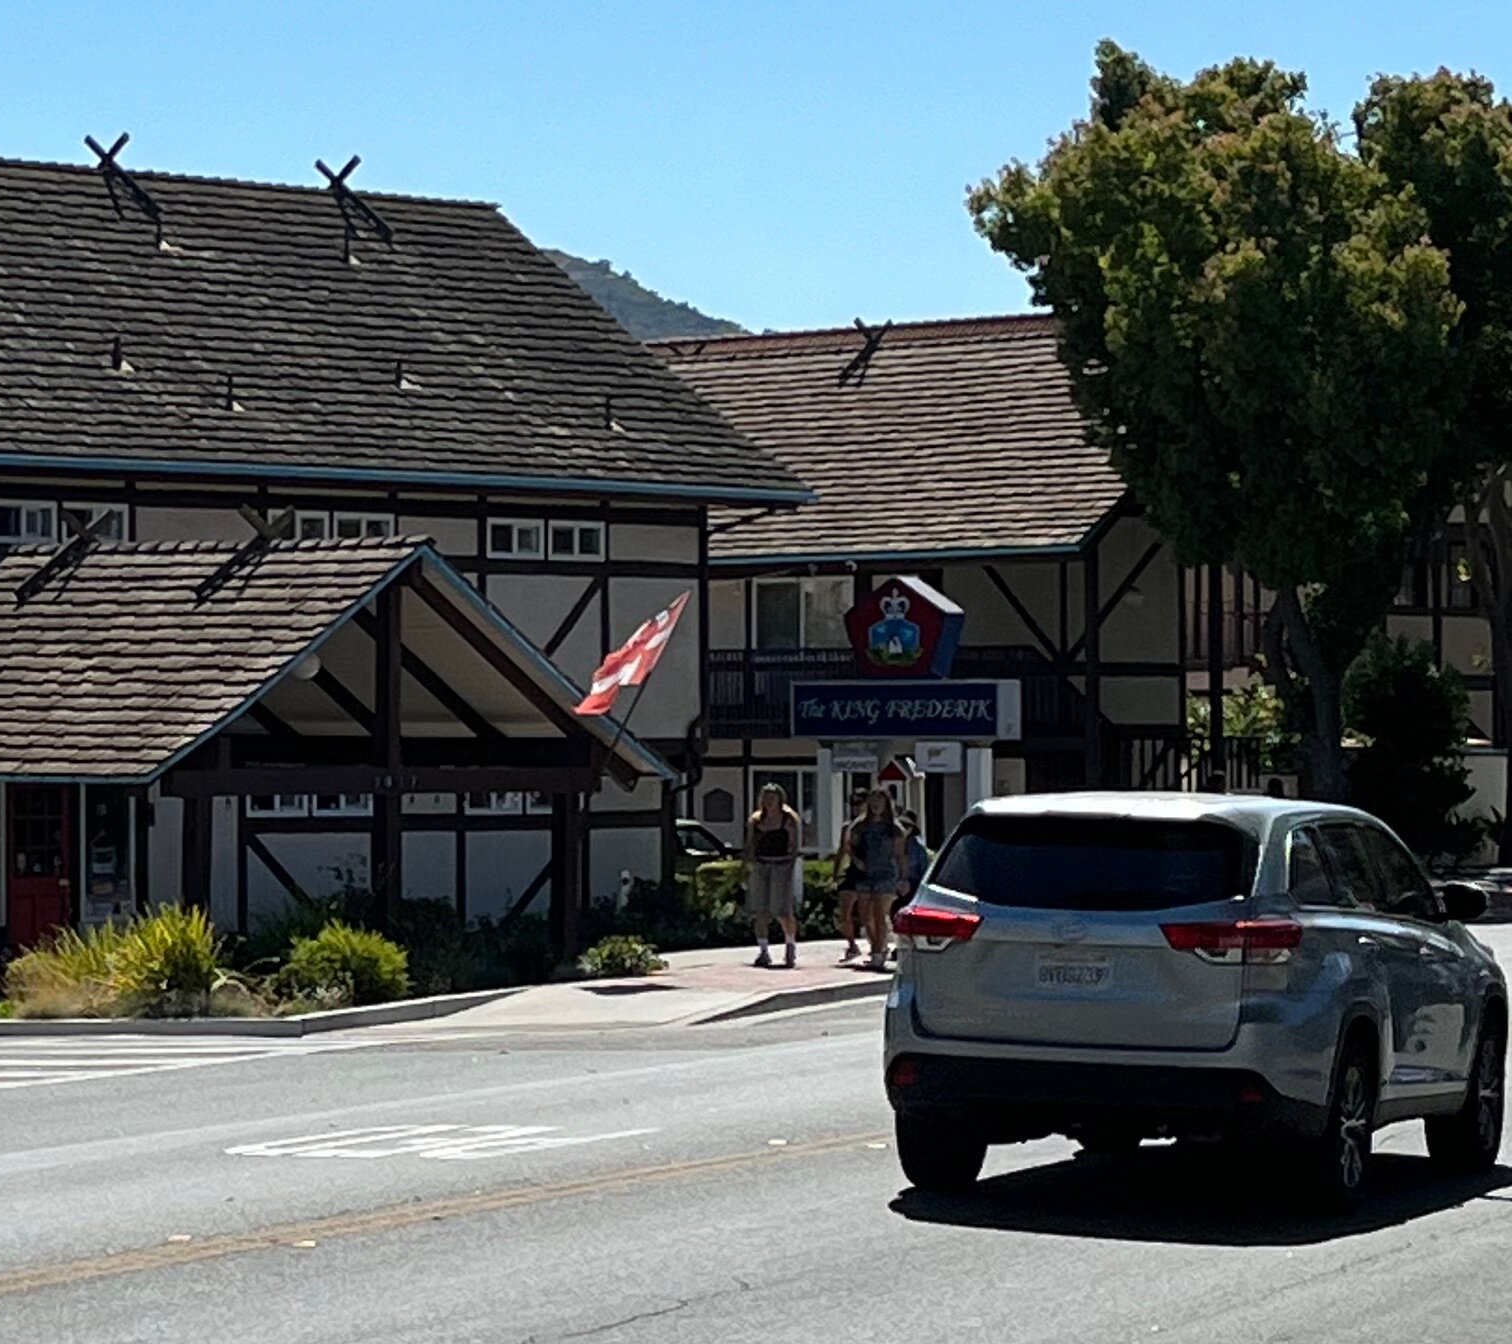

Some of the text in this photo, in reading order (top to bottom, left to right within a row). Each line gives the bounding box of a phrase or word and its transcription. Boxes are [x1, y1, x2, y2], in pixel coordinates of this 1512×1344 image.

[798, 698, 993, 724] The KING FREDERIK
